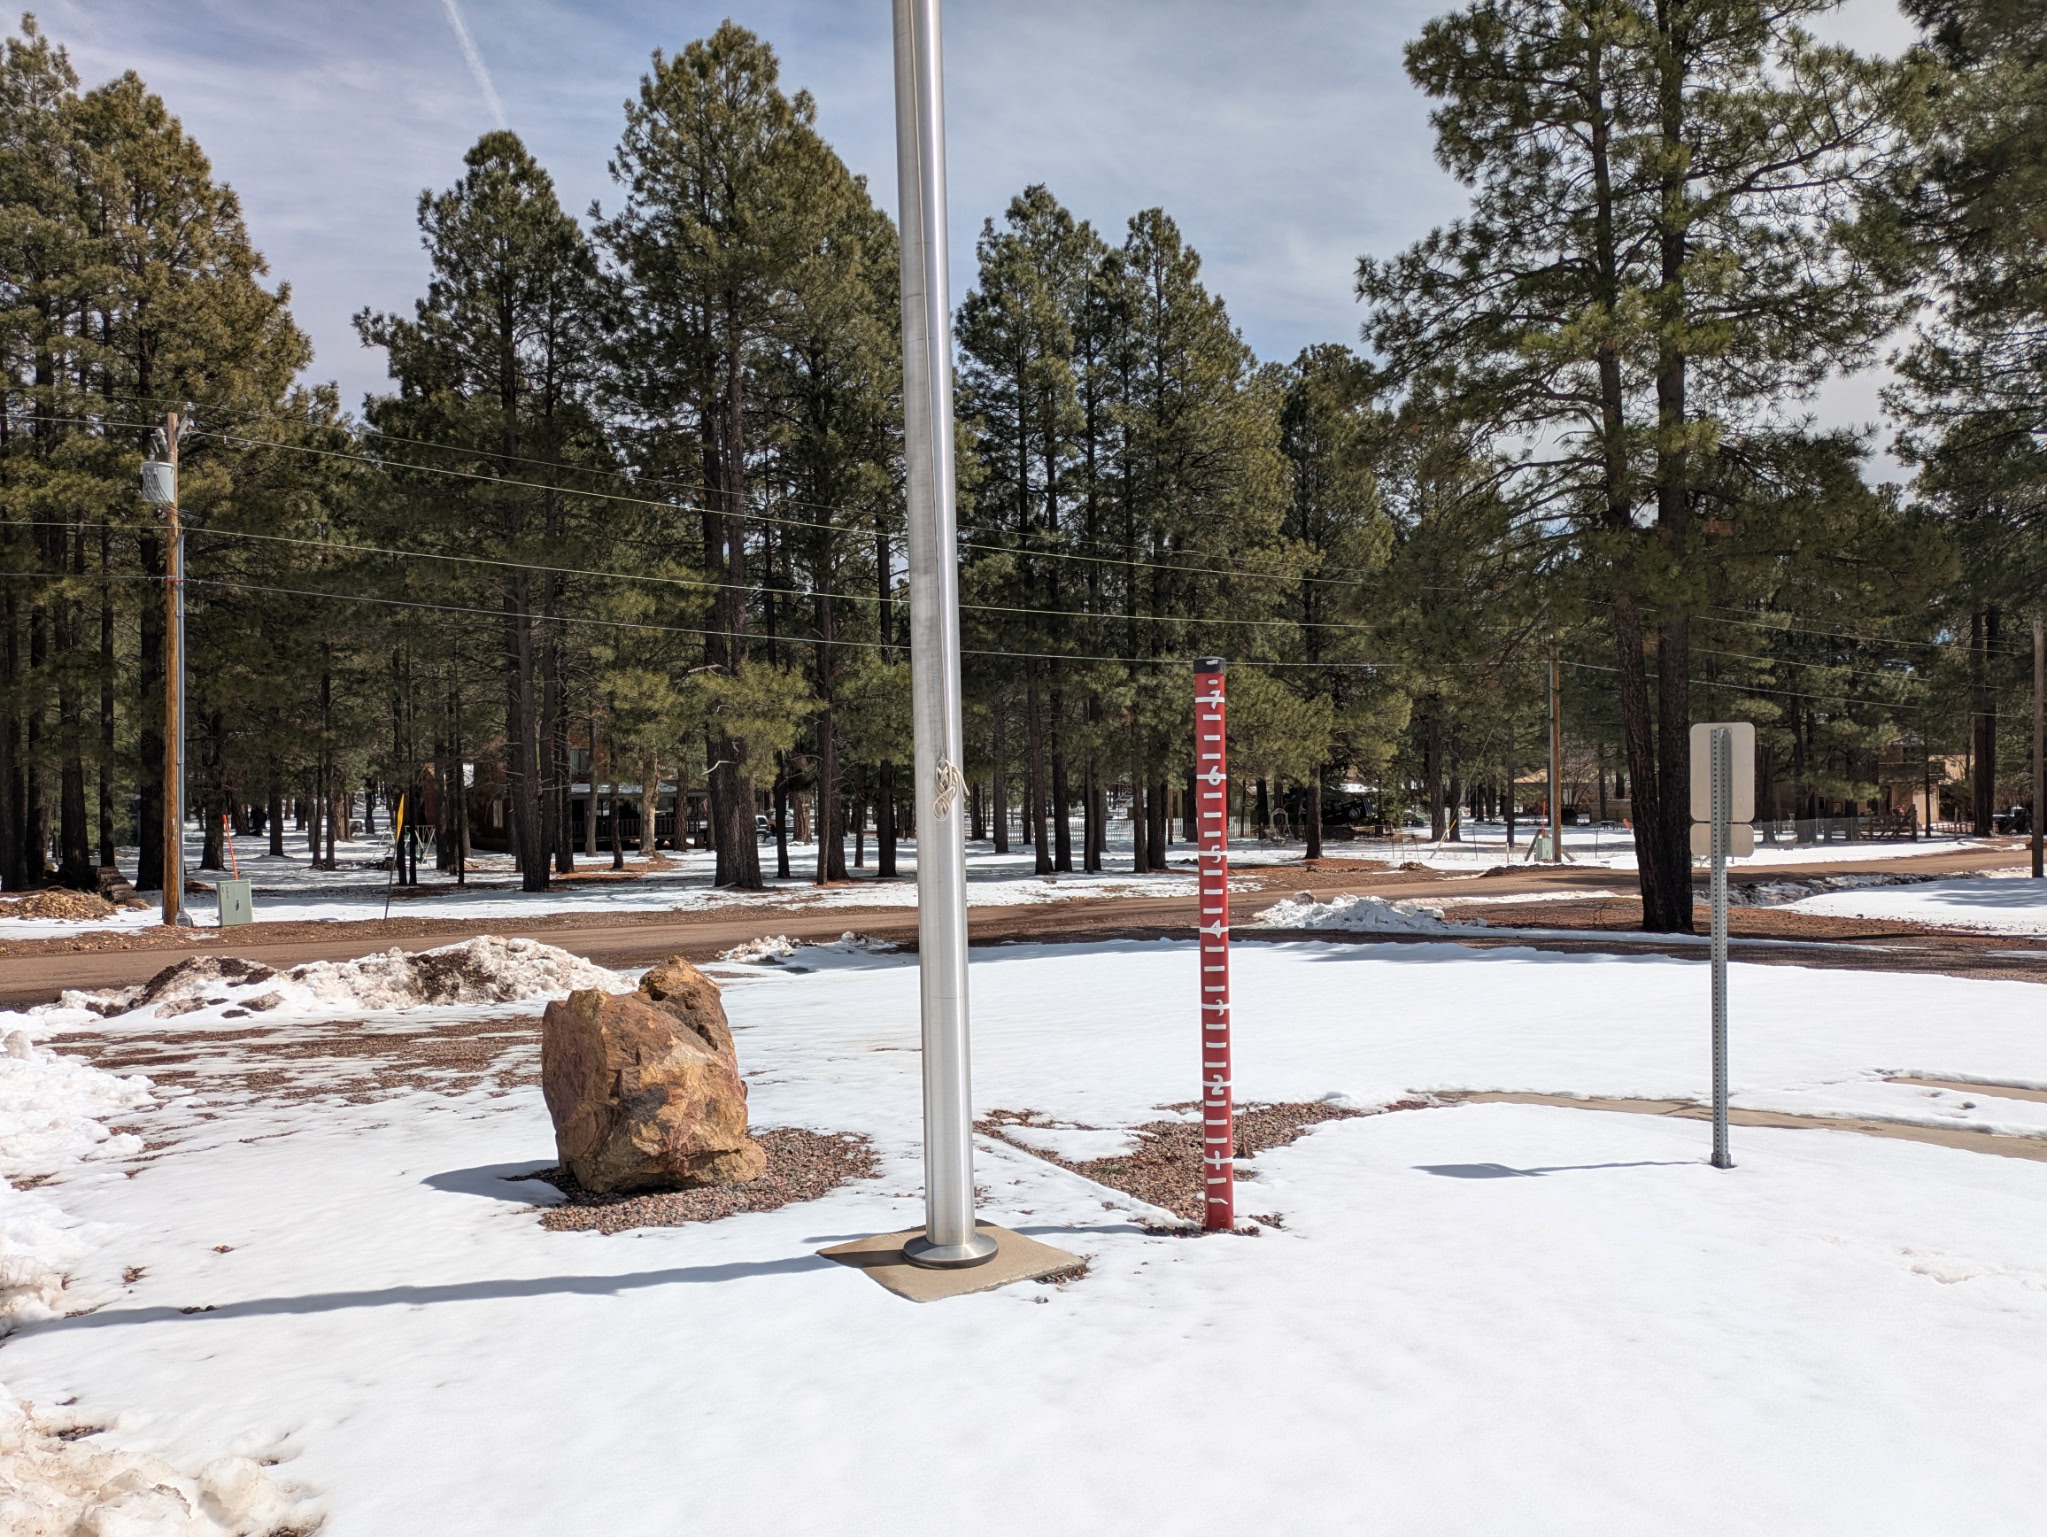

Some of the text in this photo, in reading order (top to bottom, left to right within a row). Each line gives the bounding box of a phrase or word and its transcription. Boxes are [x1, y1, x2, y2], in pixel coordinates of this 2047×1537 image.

[1209, 689, 1221, 710] 7
[1208, 765, 1221, 786] 6
[1210, 844, 1222, 864] 5
[1210, 919, 1222, 939] 4
[1215, 998, 1225, 1017] 3
[1211, 1074, 1225, 1096] 2
[1214, 1150, 1221, 1171] 1
